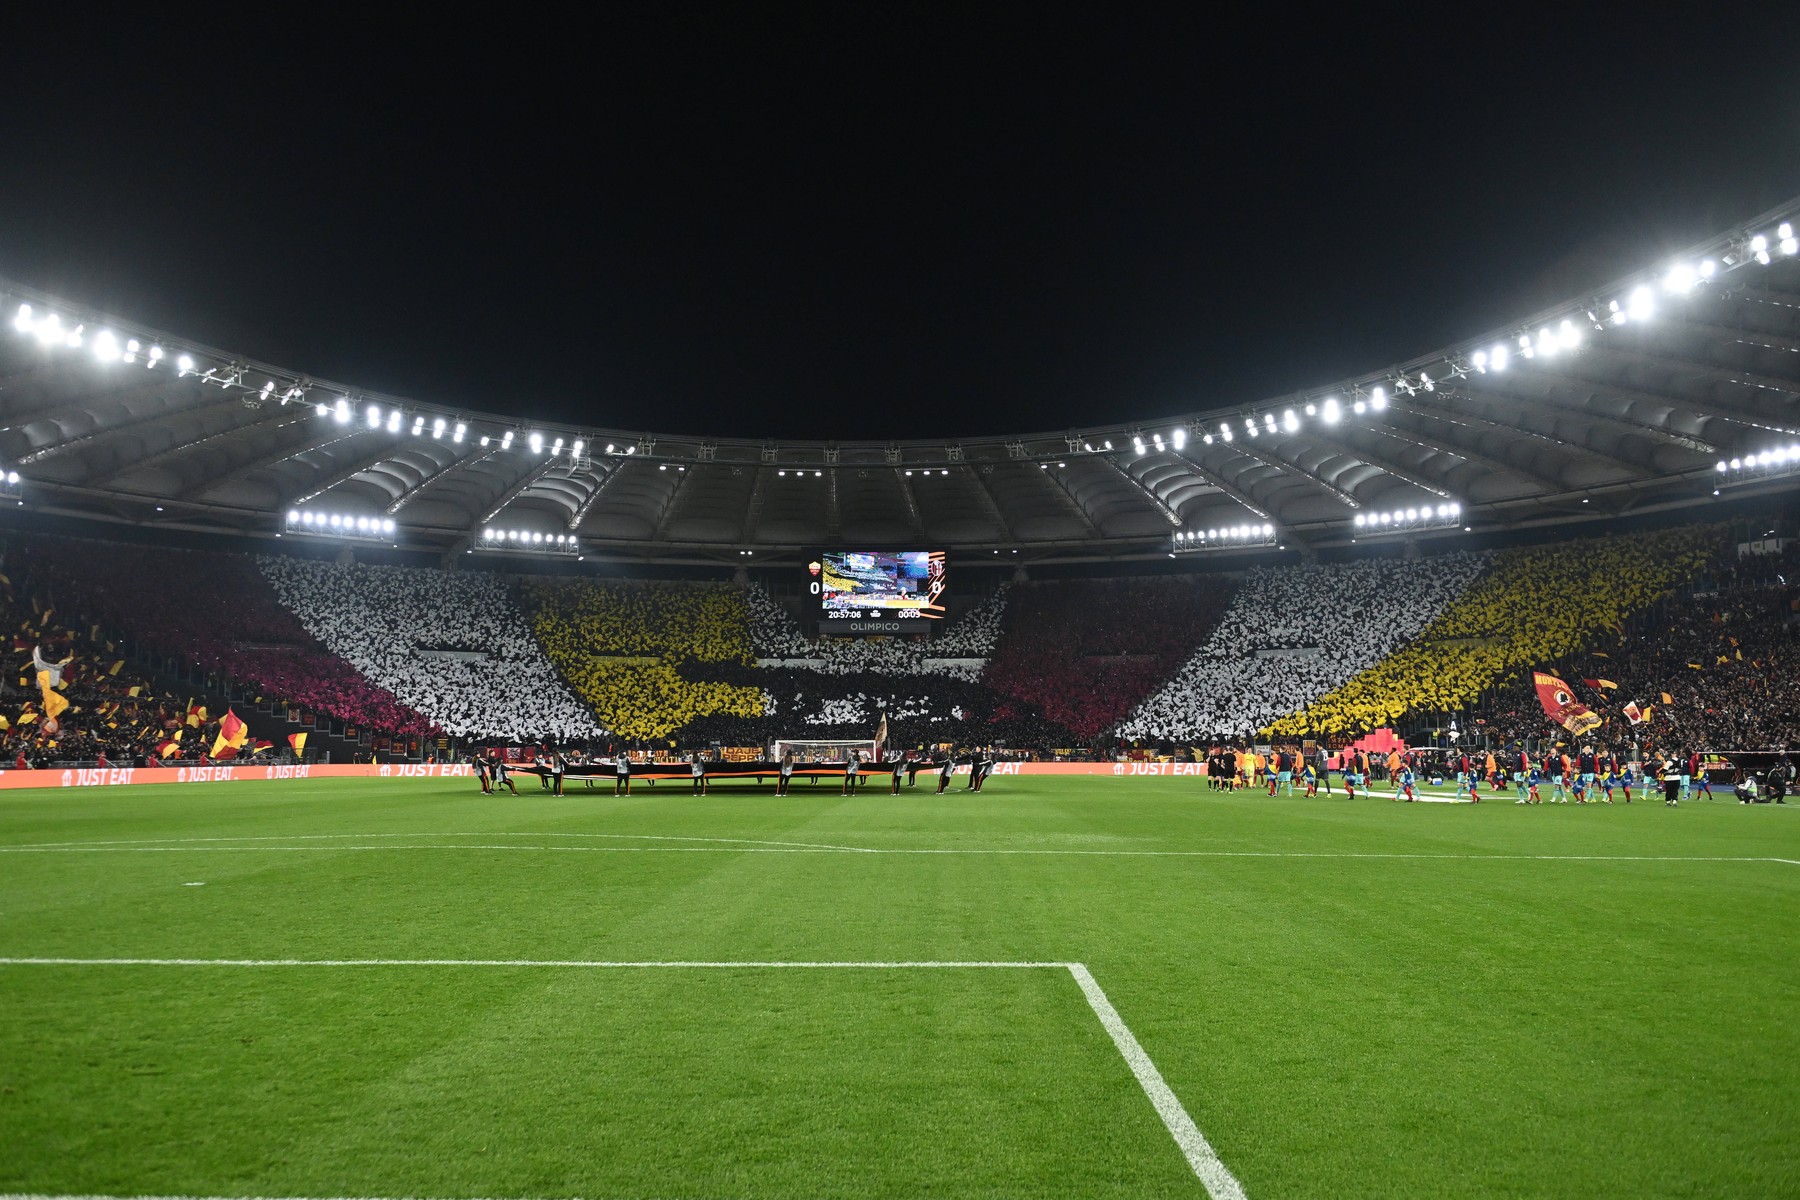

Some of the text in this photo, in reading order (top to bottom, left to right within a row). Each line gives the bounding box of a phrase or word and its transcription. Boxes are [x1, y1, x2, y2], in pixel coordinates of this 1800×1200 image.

[810, 581, 820, 595] 0
[932, 581, 942, 594] 0
[828, 610, 862, 619] 20:57:06
[850, 622, 900, 631] OLIMPICO
[725, 747, 761, 755] DAJE
[722, 754, 758, 762] PEPP
[188, 766, 234, 782] JUST EAT
[275, 764, 311, 779] JUST EAT
[396, 763, 473, 777] JUST EAT
[991, 762, 1024, 775] EAT
[1129, 762, 1205, 775] JUST EAT
[76, 768, 135, 786] JUST EAT
